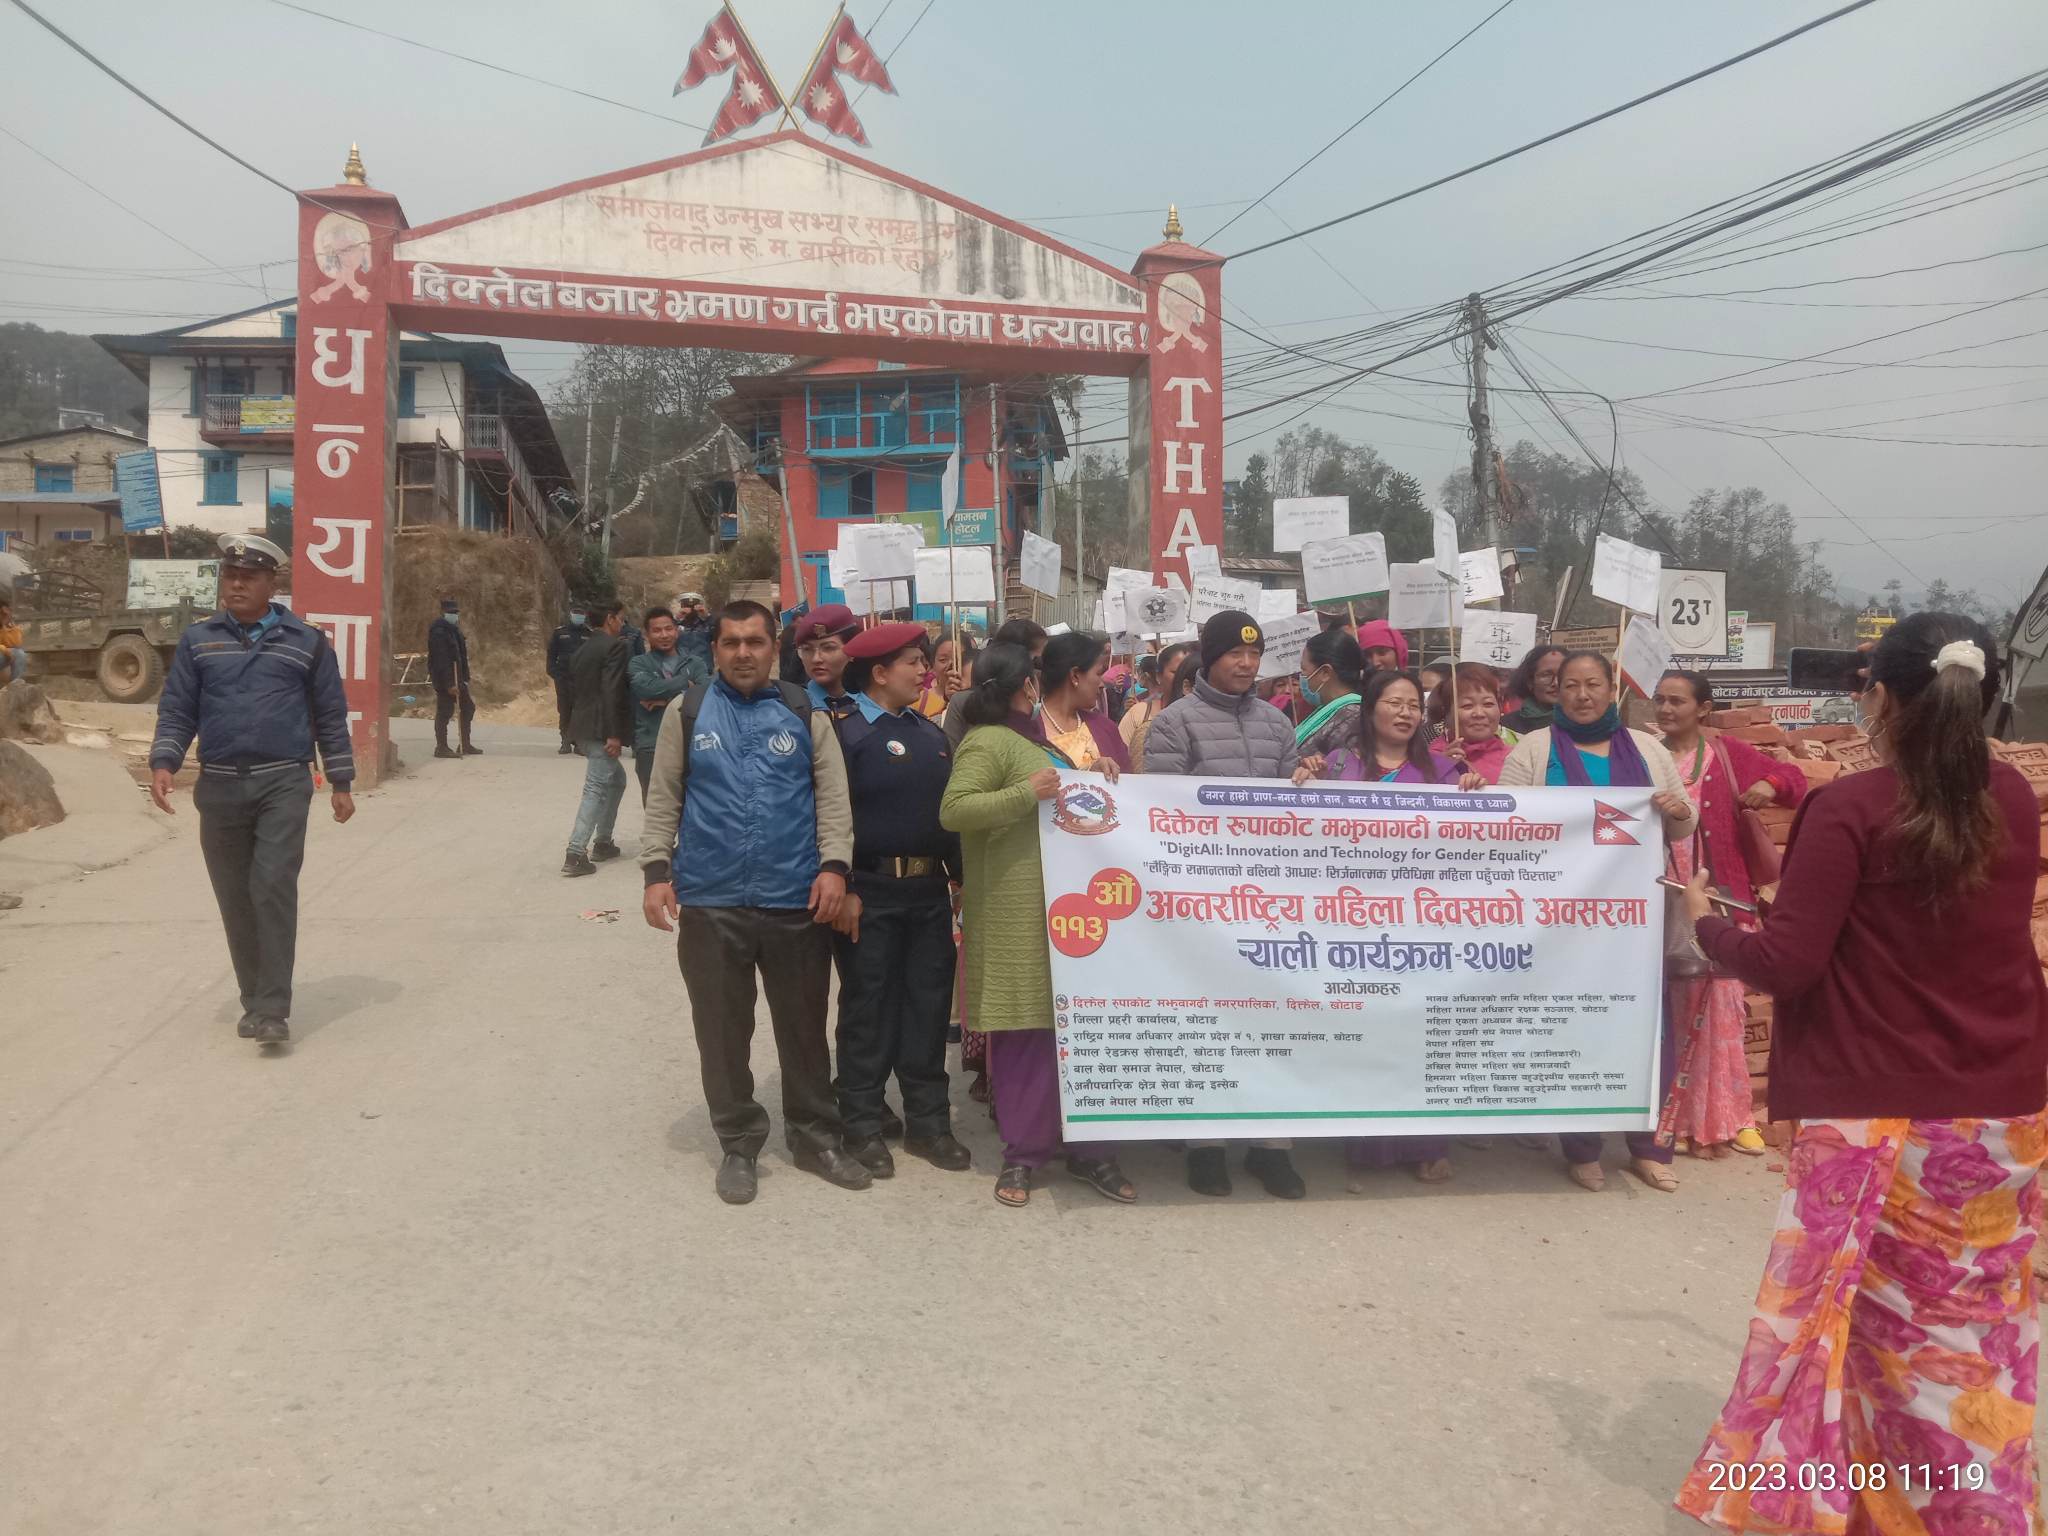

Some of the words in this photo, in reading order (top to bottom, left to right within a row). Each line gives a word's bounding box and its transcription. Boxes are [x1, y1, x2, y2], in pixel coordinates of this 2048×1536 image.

[409, 263, 553, 311] दिक्तेल
[557, 279, 660, 319] बजार
[664, 290, 767, 323] भ्रमण
[845, 300, 994, 338] भएकोमा
[1437, 816, 1563, 842] नगरपालिका
[1160, 841, 1222, 857] "DigitAll:
[1226, 843, 1298, 857] Innovation
[1303, 846, 1327, 858] and
[1330, 846, 1408, 863] Technology
[1411, 848, 1431, 860] for
[1435, 848, 1485, 861] Gender
[1489, 848, 1547, 864] Equality"
[1146, 884, 1304, 930] अन्तर्राष्ट्रिय
[1313, 886, 1406, 929] महिला
[1413, 887, 1524, 930] दिवसको
[1533, 897, 1648, 929] अवसरमा
[1051, 914, 1104, 942] ११३
[1324, 979, 1400, 995] आयोजकहरू
